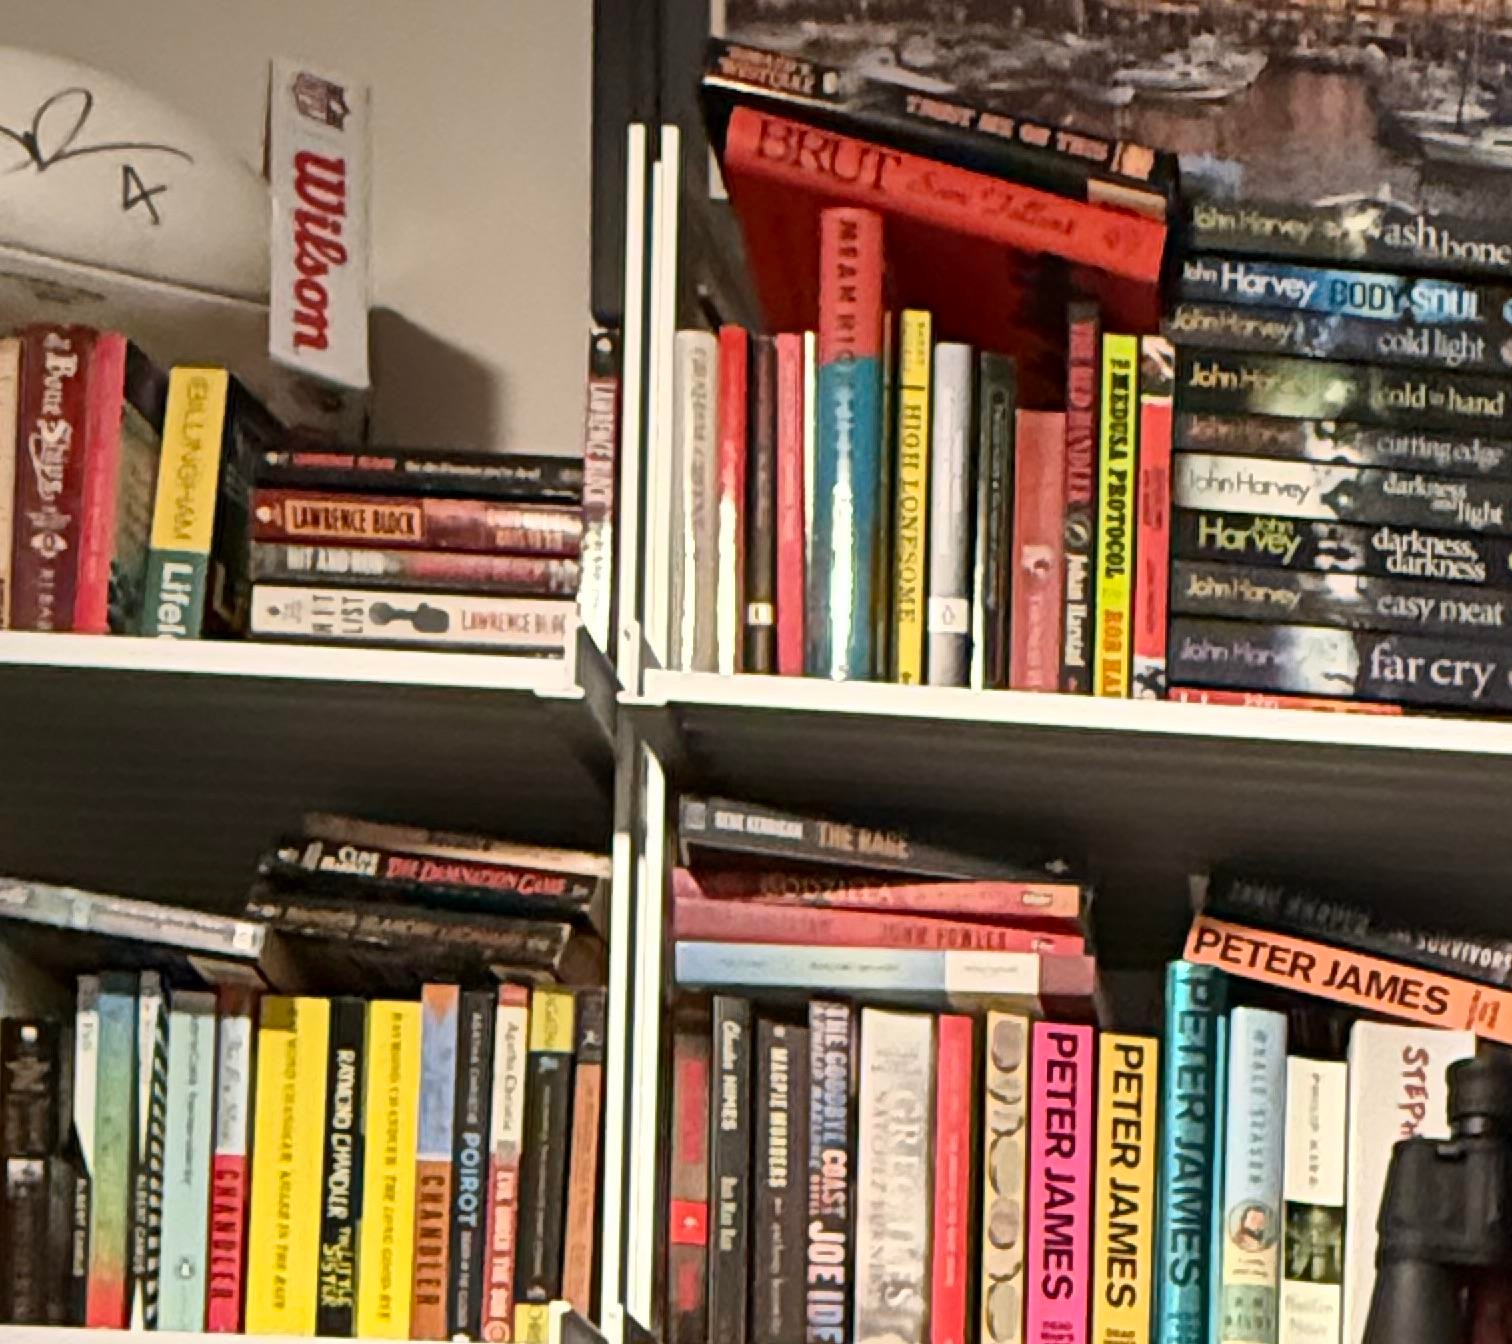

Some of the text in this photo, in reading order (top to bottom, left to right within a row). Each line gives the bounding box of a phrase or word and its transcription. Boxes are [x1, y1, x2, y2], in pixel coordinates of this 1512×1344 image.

[757, 121, 903, 193] BRUT
[121, 164, 167, 225] 4
[294, 149, 348, 353] Wilson
[1381, 217, 1511, 266] ash bone
[1221, 262, 1485, 323] Harvey BODY SOUL
[1103, 374, 1135, 579] MEDUSA PROTOCOL
[290, 503, 418, 536] LAWRENCE BLOCK
[900, 402, 922, 625] HIGH LONESOME
[1198, 516, 1301, 563] Harvey
[1386, 553, 1486, 582] darkness
[1376, 593, 1504, 626] easy meat
[1370, 645, 1496, 698] far cry
[1192, 926, 1450, 1016] PETER JAMES
[458, 1131, 481, 1228] POIROT
[1041, 1031, 1079, 1300] PETER JAMES
[1105, 1043, 1144, 1309] PETER JAMES
[210, 1169, 239, 1300] CHANDLER
[807, 1220, 846, 1283] JOE
